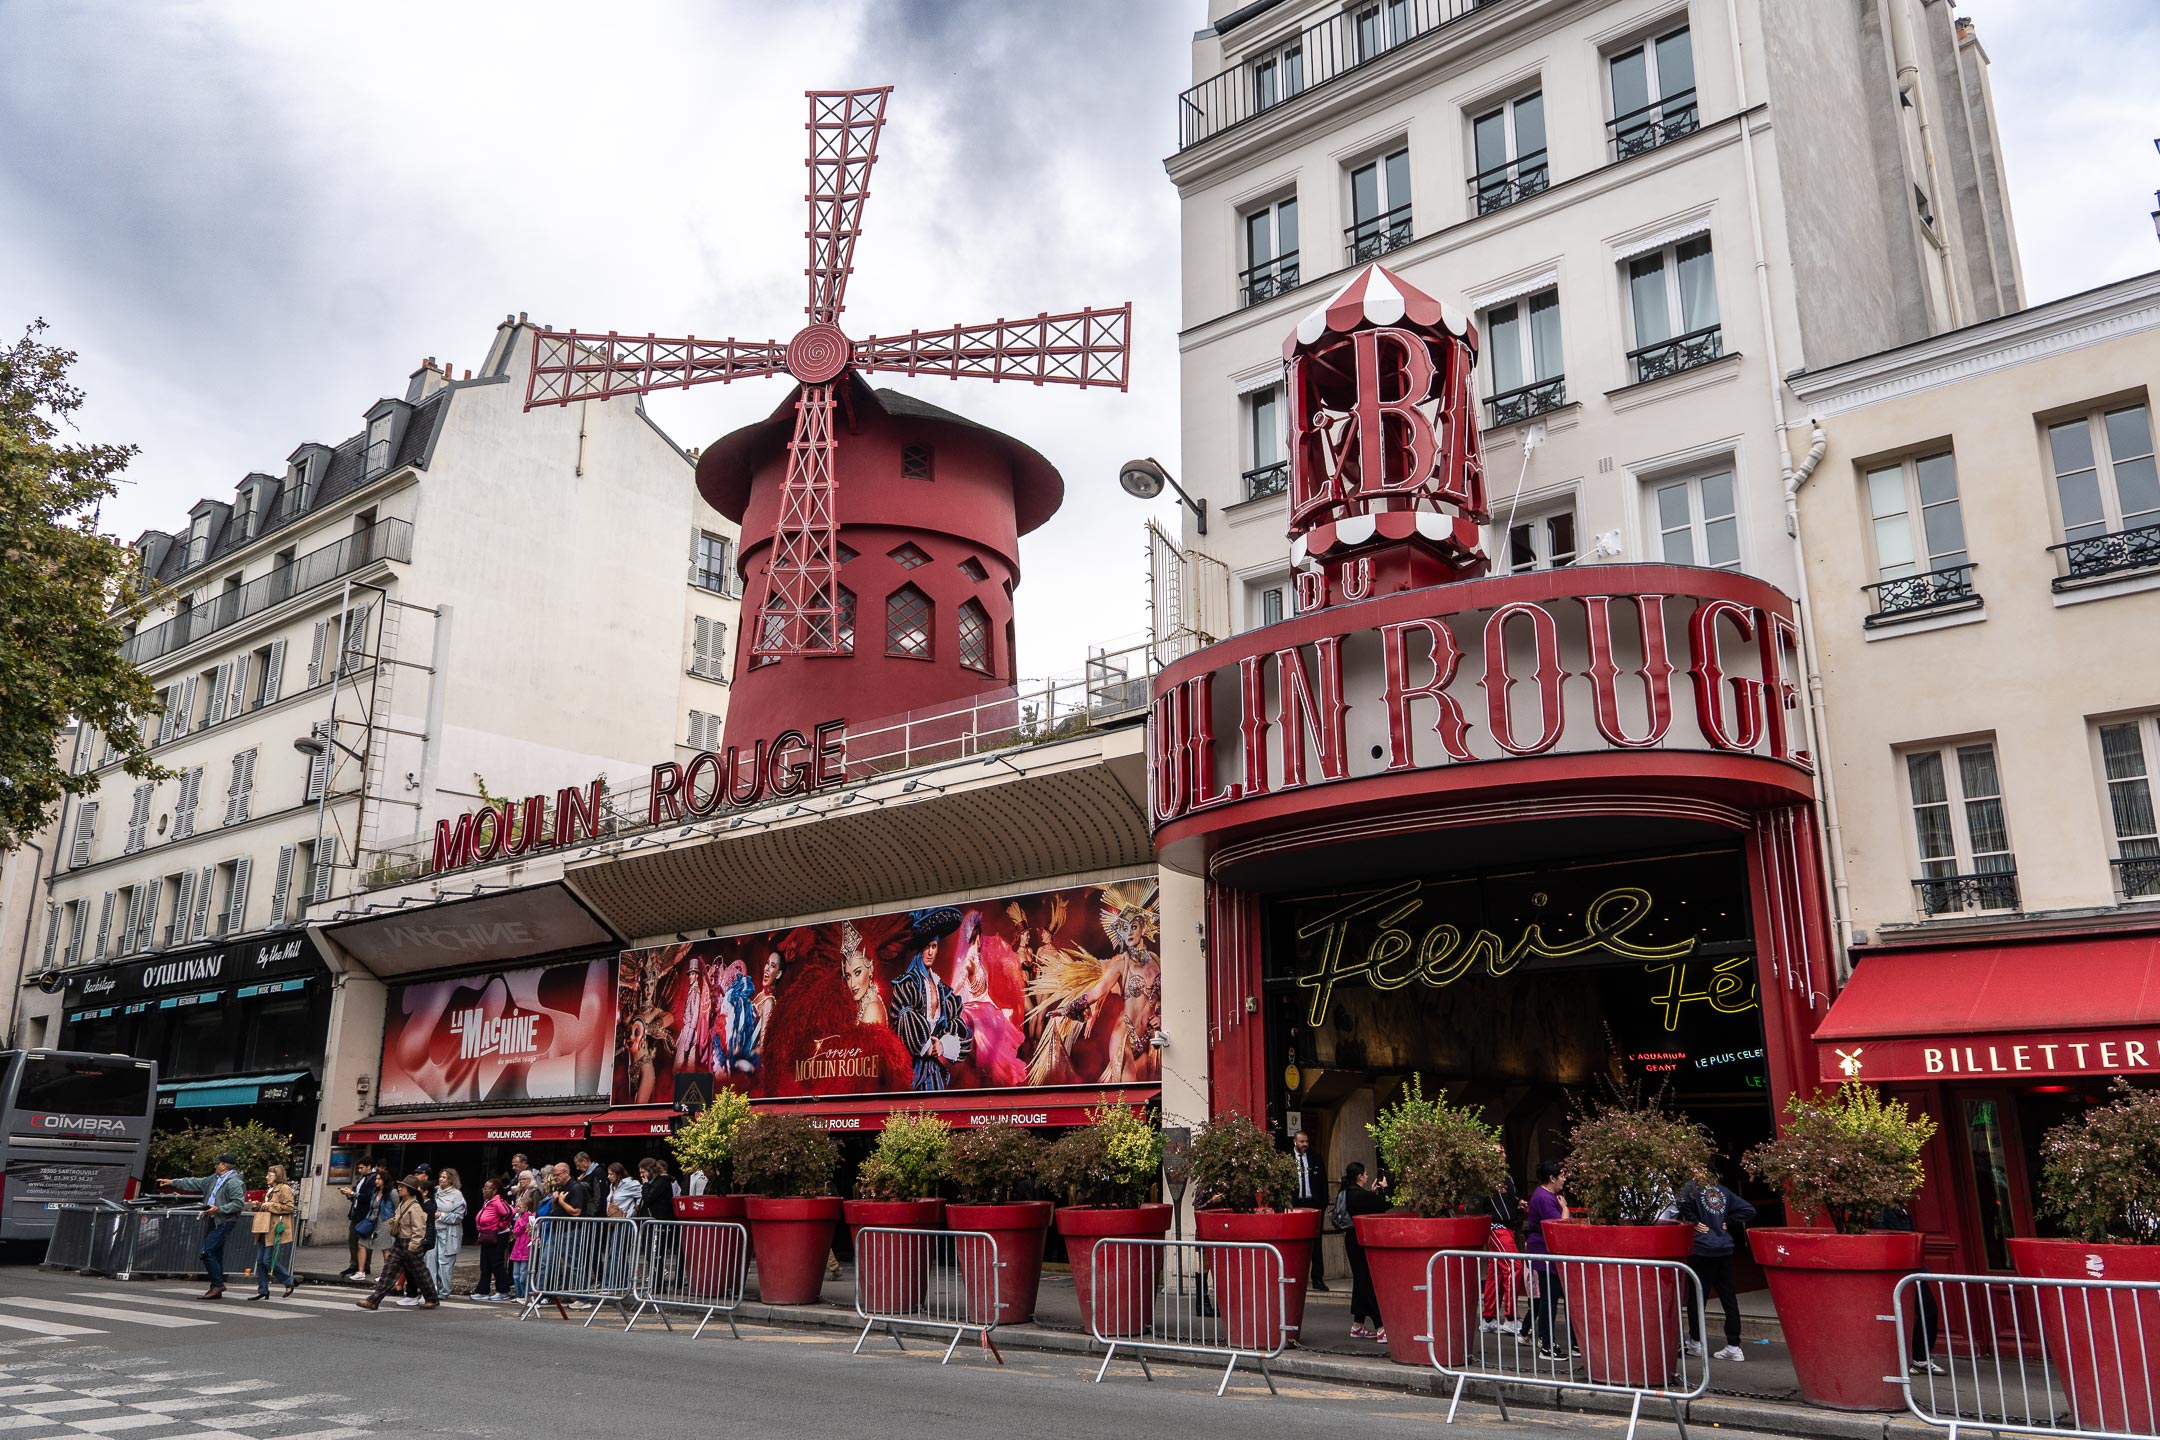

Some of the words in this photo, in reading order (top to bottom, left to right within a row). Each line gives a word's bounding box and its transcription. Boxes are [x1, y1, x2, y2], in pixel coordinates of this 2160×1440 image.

[1297, 557, 1377, 612] DU
[1149, 633, 1352, 832] ULIN
[1376, 594, 1815, 774] ROUGE
[432, 779, 600, 872] MOULIN
[648, 717, 849, 826] ROUGE
[257, 947, 268, 969] By
[268, 944, 282, 962] the
[281, 940, 302, 961] Mill
[1298, 879, 1697, 1027] Féerie
[143, 954, 225, 988] O'SULLIVANS
[83, 976, 117, 995] Backstage
[1645, 957, 1758, 1031] Fé
[451, 1010, 463, 1029] LA
[807, 1034, 863, 1060] Forever
[1637, 1052, 1687, 1061] AQUARIUM
[1924, 1040, 2160, 1073] BILLETTER
[795, 1059, 836, 1082] MOULIN
[839, 1054, 879, 1078] ROUGE
[1645, 1063, 1677, 1072] GEANT
[1695, 1057, 1708, 1069] LE
[1709, 1053, 1736, 1066] PLUS
[31, 1114, 126, 1131] COÏMBRA
[650, 1124, 672, 1133] MOUL
[830, 1119, 860, 1128] ROUGE
[1011, 1113, 1047, 1125] ROUGE
[379, 1133, 399, 1141] MOULIN
[399, 1132, 417, 1140] ROUGE
[487, 1131, 510, 1139] MOULIN
